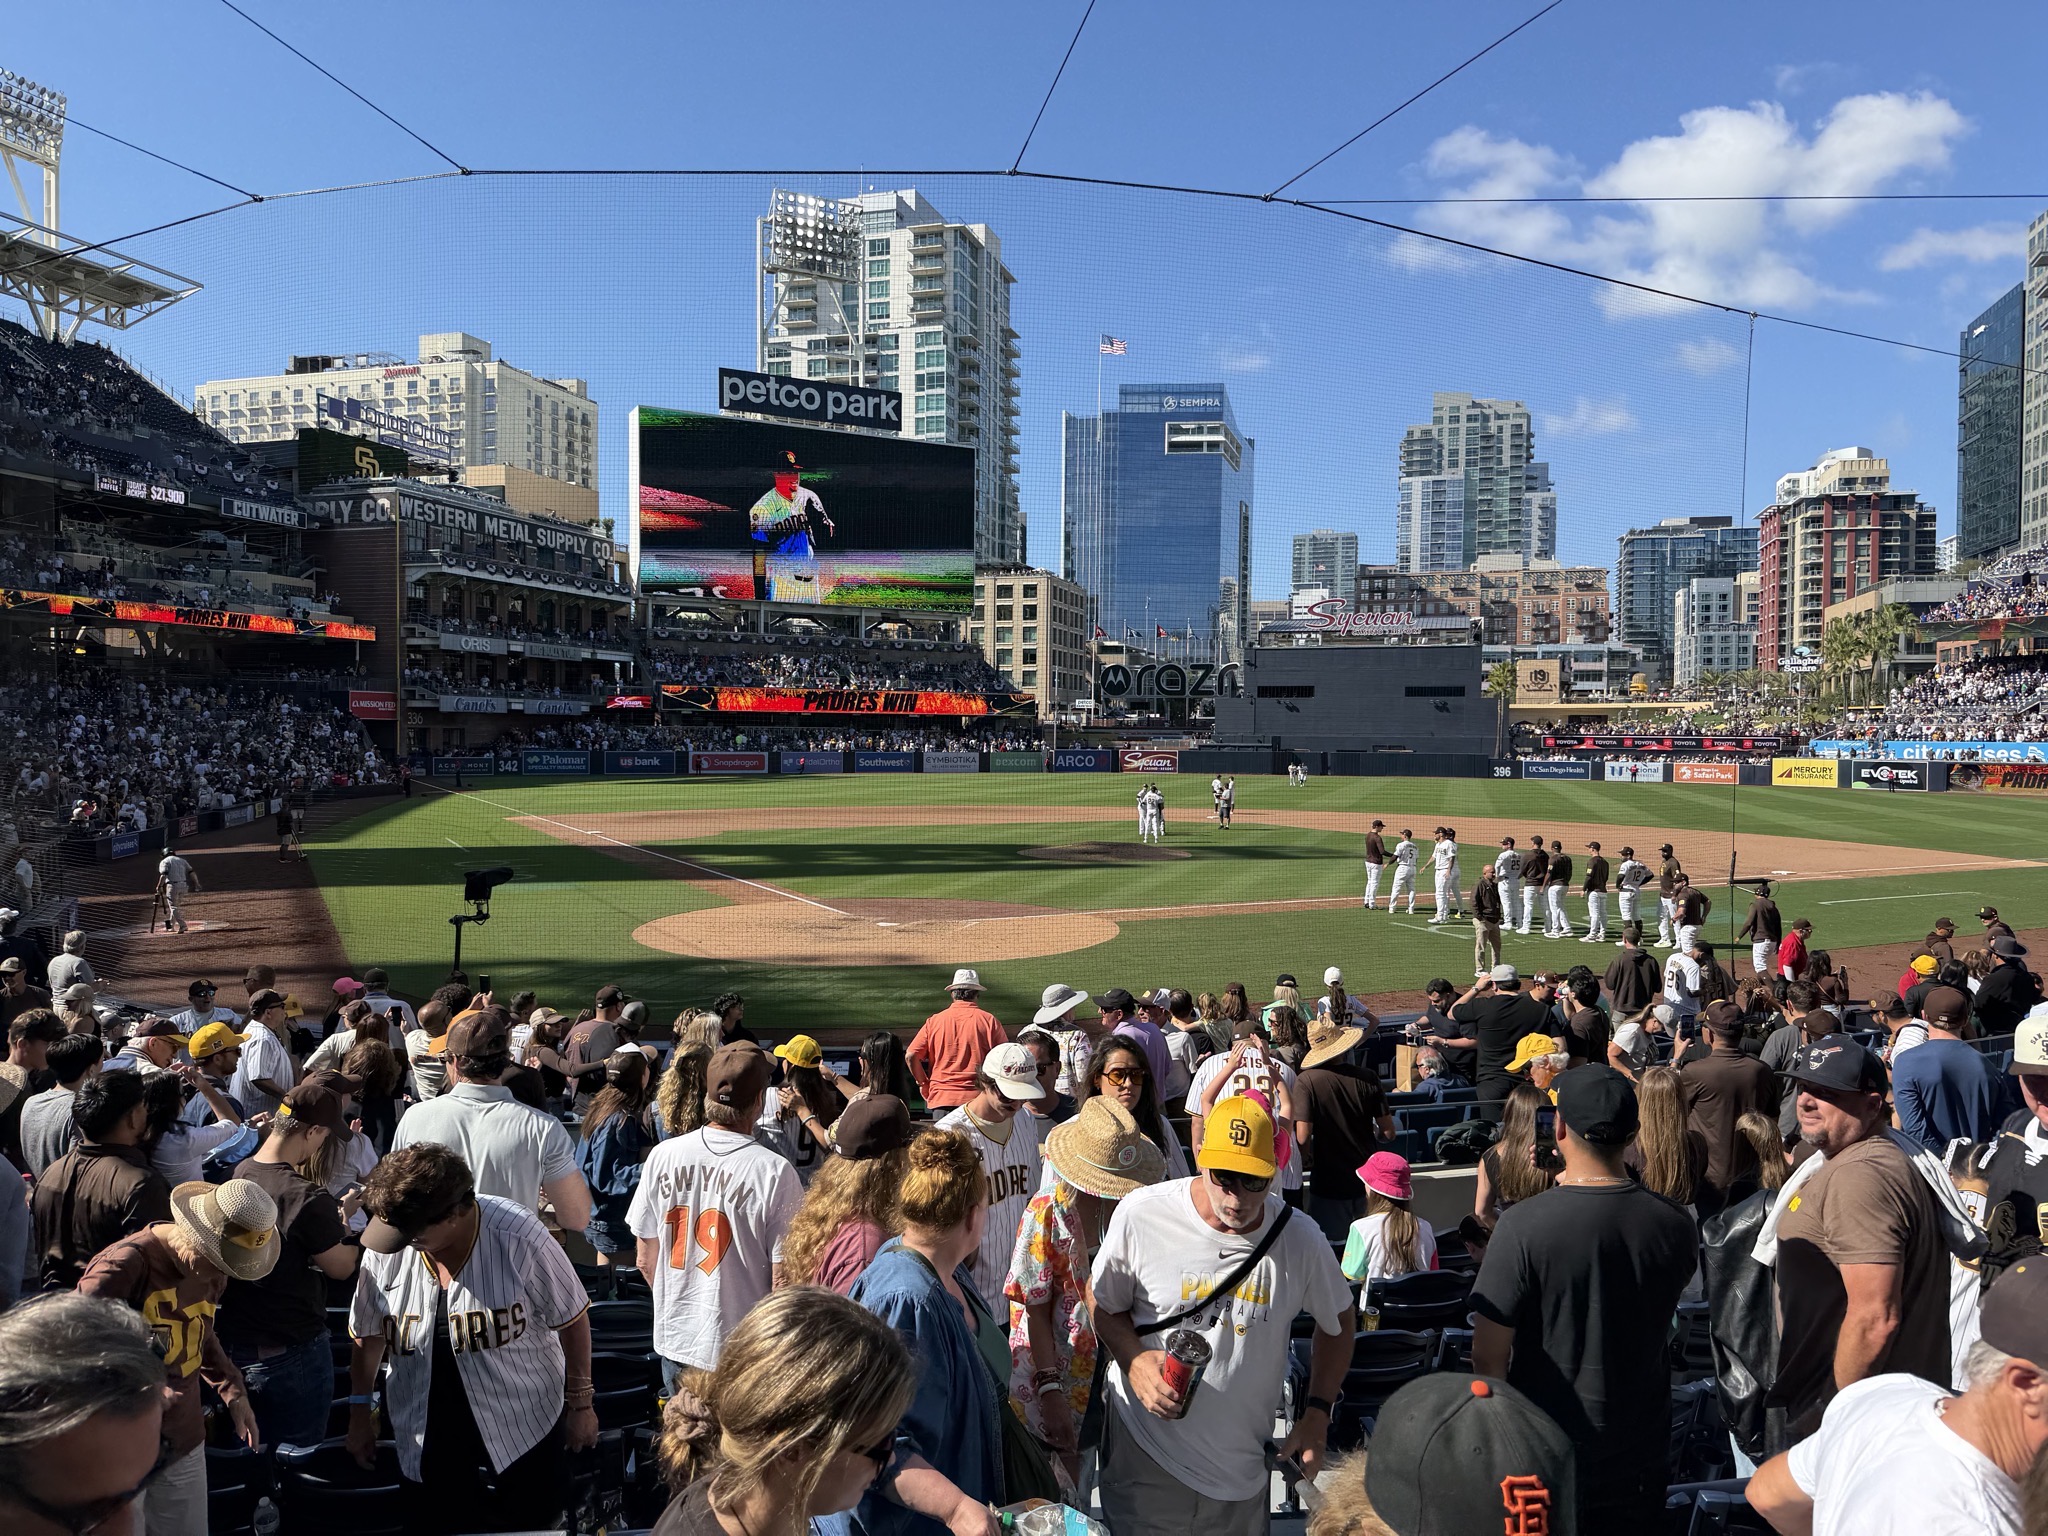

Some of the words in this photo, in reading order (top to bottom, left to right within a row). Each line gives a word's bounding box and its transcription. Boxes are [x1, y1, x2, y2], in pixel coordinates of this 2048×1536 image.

[723, 376, 821, 410] petco
[827, 391, 898, 421] park
[1180, 399, 1220, 407] SEMPRA
[366, 406, 452, 446] QuidelOrtho
[126, 480, 147, 490] TODAY'S
[151, 485, 185, 505] $21,900
[233, 500, 299, 527] CUTWATER
[361, 498, 396, 522] CO.
[399, 496, 477, 532] WESTERN
[485, 515, 533, 543] METAL
[537, 528, 587, 555] SUPPLY
[592, 541, 613, 561] CO.
[175, 607, 225, 627] PADRES
[228, 613, 251, 629] WIN
[1305, 598, 1417, 636] Sycuan
[461, 637, 491, 651] ORIS
[1777, 657, 1825, 667] Gallagher
[1783, 664, 1817, 674] Square
[1136, 662, 1241, 697] razr
[360, 700, 384, 708] MISSION
[454, 697, 497, 713] Canel's
[537, 701, 573, 715] Canel's
[614, 697, 643, 708] Sycuan
[803, 691, 877, 712] PADRES
[881, 692, 919, 713] WIN
[407, 712, 424, 725] 336
[499, 760, 518, 772] 342
[543, 755, 586, 765] Palomar
[620, 757, 633, 766] us
[634, 756, 660, 766] bank
[714, 757, 759, 767] Snapdragon
[858, 757, 904, 767] Southwest
[1056, 755, 1095, 767] ARCO
[1123, 752, 1172, 771] Sycuan
[1493, 766, 1511, 777] 396
[1539, 766, 1550, 774] San
[1550, 766, 1565, 775] Diego
[1693, 771, 1715, 779] Safari
[1716, 772, 1733, 780] Park
[1794, 766, 1833, 774] MERCURY
[1409, 849, 1414, 859] 5
[1511, 859, 1520, 871] 25
[1633, 871, 1641, 881] 12
[2030, 1033, 2043, 1045] SAN
[1233, 1074, 1275, 1108] 23
[1228, 1118, 1252, 1148] SD
[658, 1164, 754, 1211] GWYNN
[665, 1205, 733, 1277] 19
